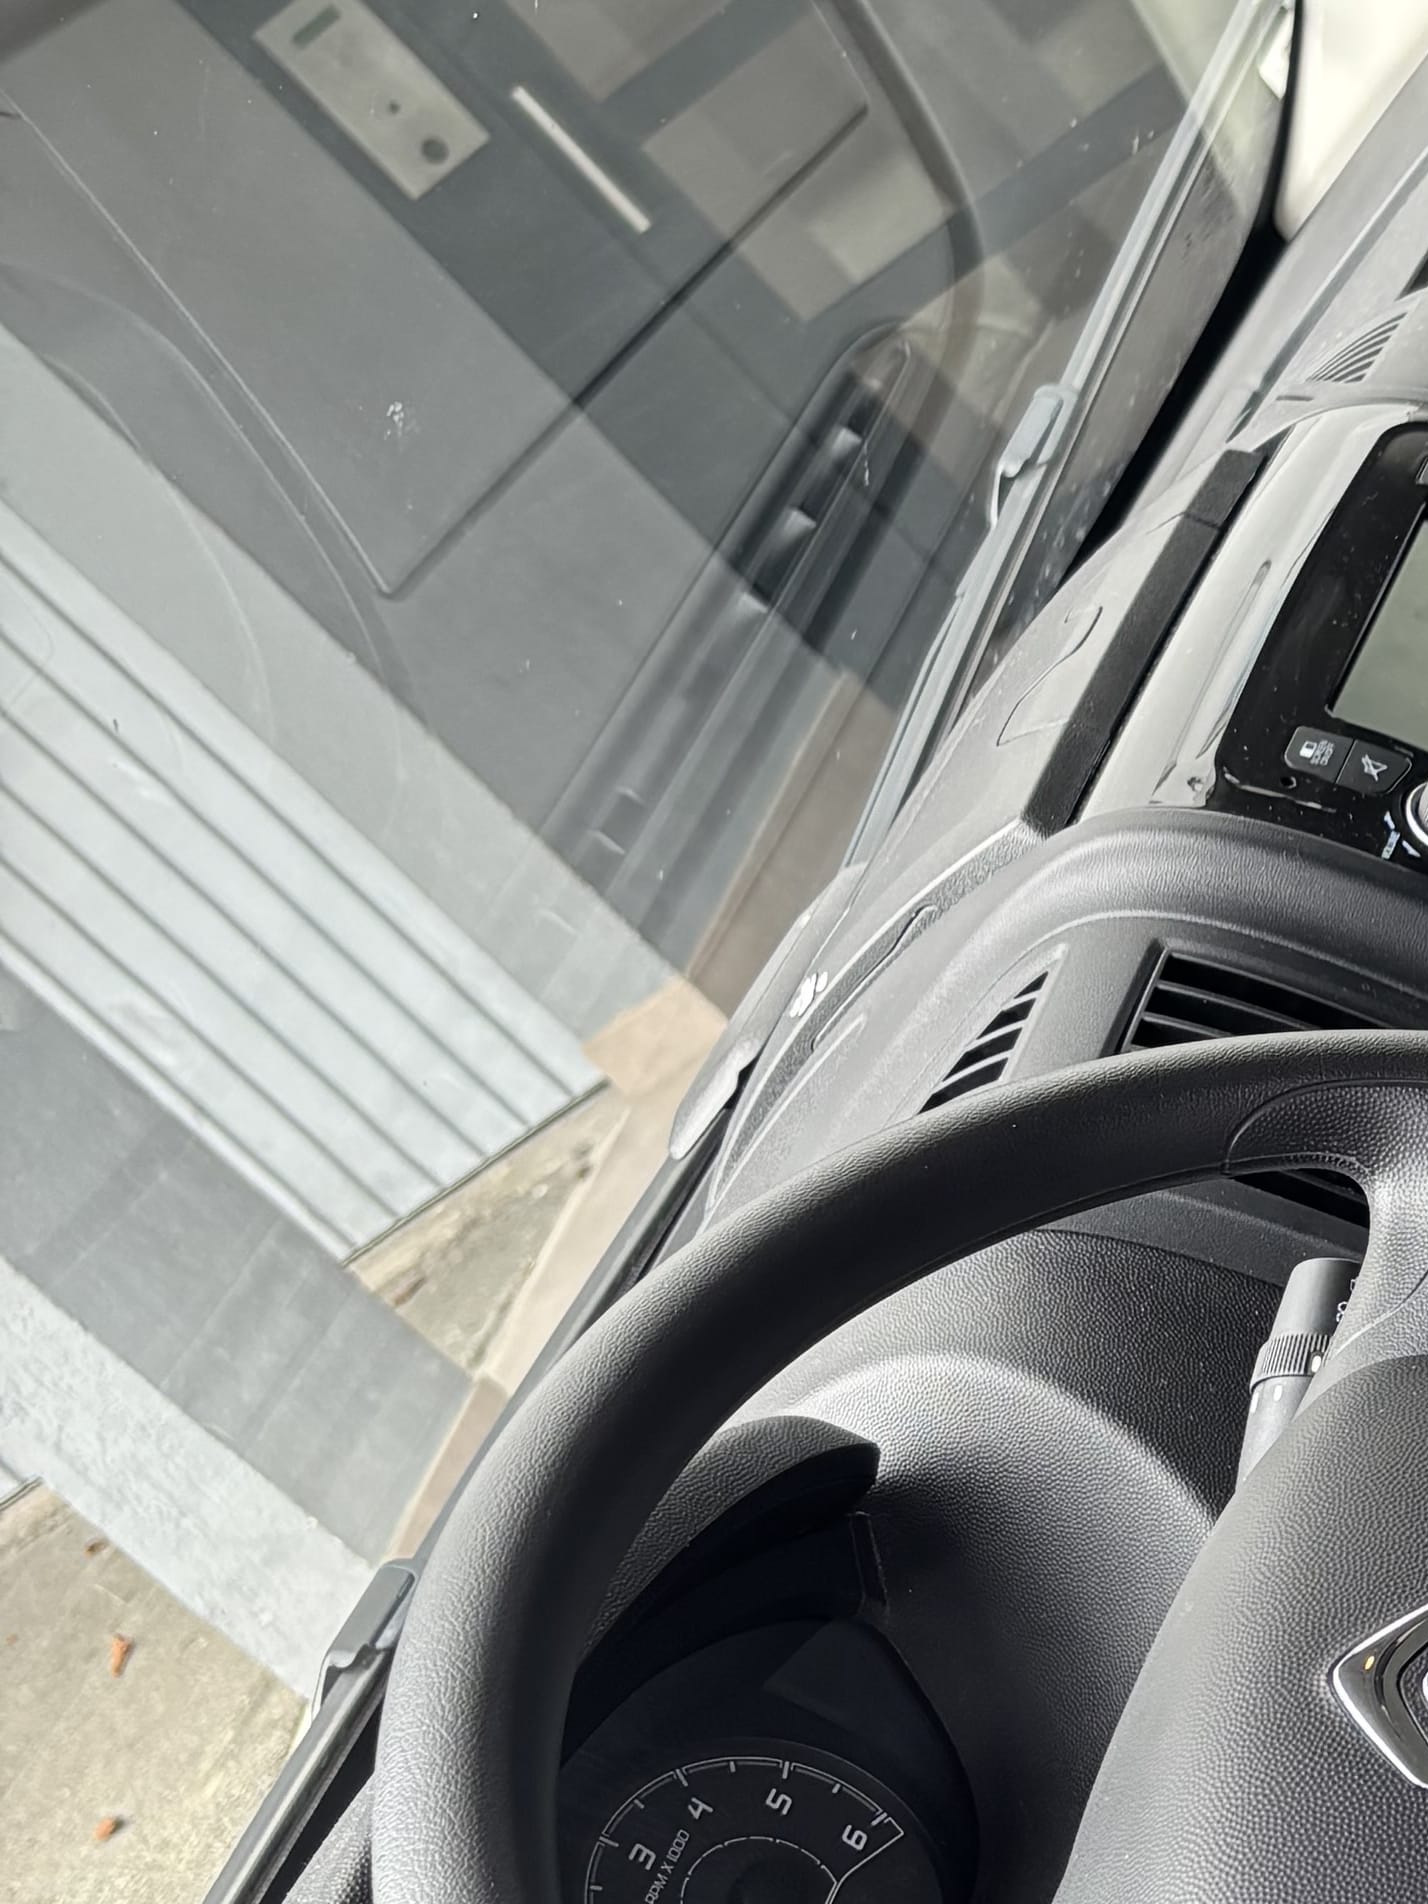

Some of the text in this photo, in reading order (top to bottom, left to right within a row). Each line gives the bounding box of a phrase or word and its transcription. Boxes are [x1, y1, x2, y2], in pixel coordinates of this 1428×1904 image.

[687, 1797, 714, 1820] 4
[766, 1788, 794, 1815] 5
[842, 1824, 868, 1852] 6
[629, 1843, 657, 1871] 3
[645, 1873, 669, 1904] RPM
[666, 1829, 690, 1863] 1000
